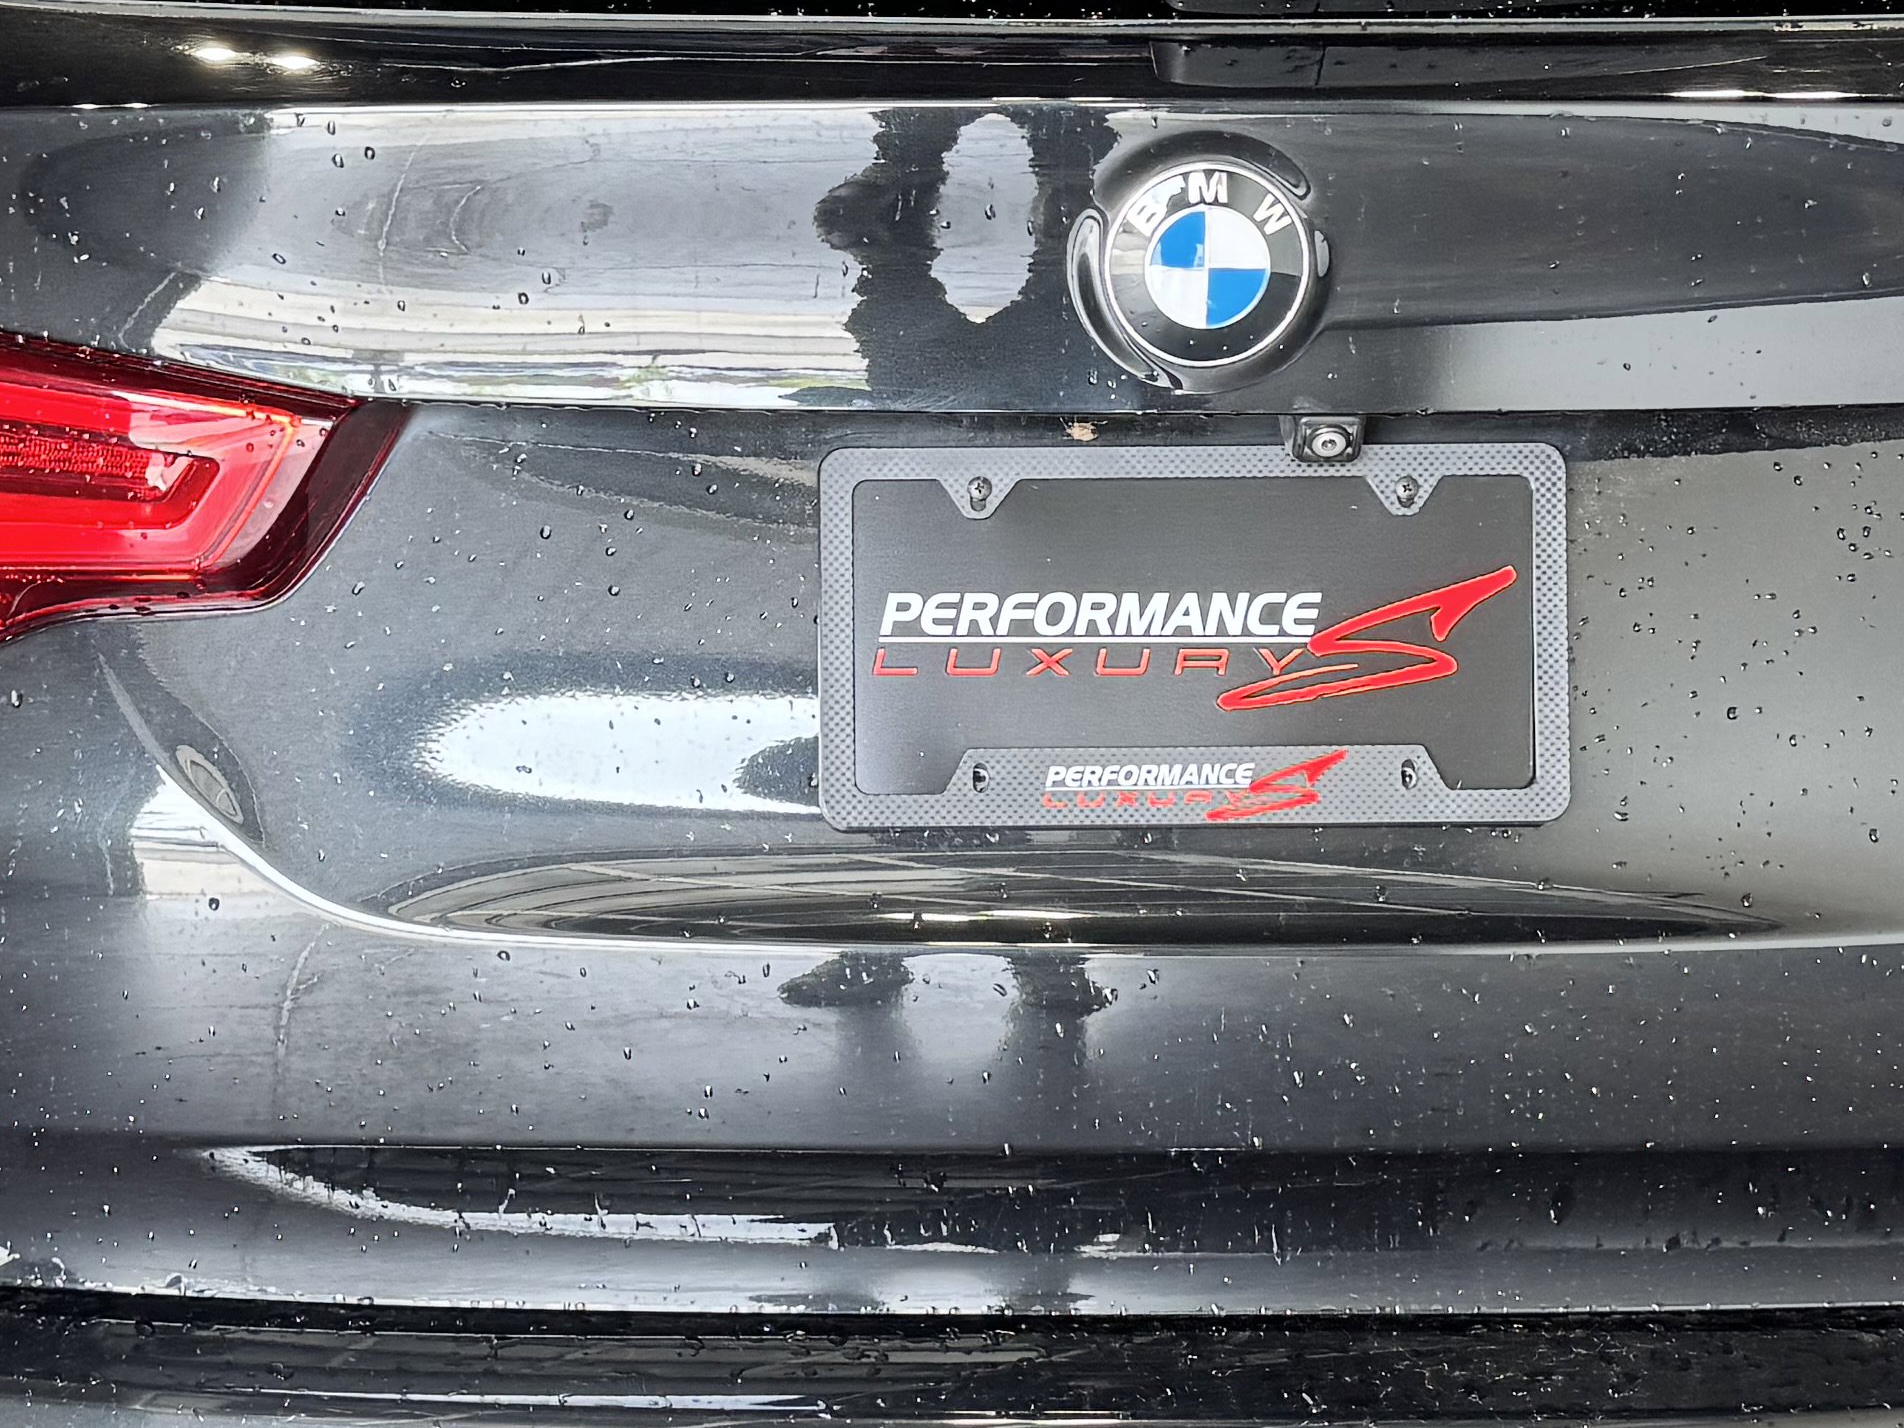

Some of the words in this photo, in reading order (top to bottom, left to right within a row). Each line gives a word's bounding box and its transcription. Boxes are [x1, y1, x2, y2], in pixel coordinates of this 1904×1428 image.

[1124, 170, 1293, 237] BMW
[879, 591, 1324, 637] PERFORMANCE
[872, 646, 1304, 677] LUXURY
[1045, 762, 1256, 788] PERFORMANCE
